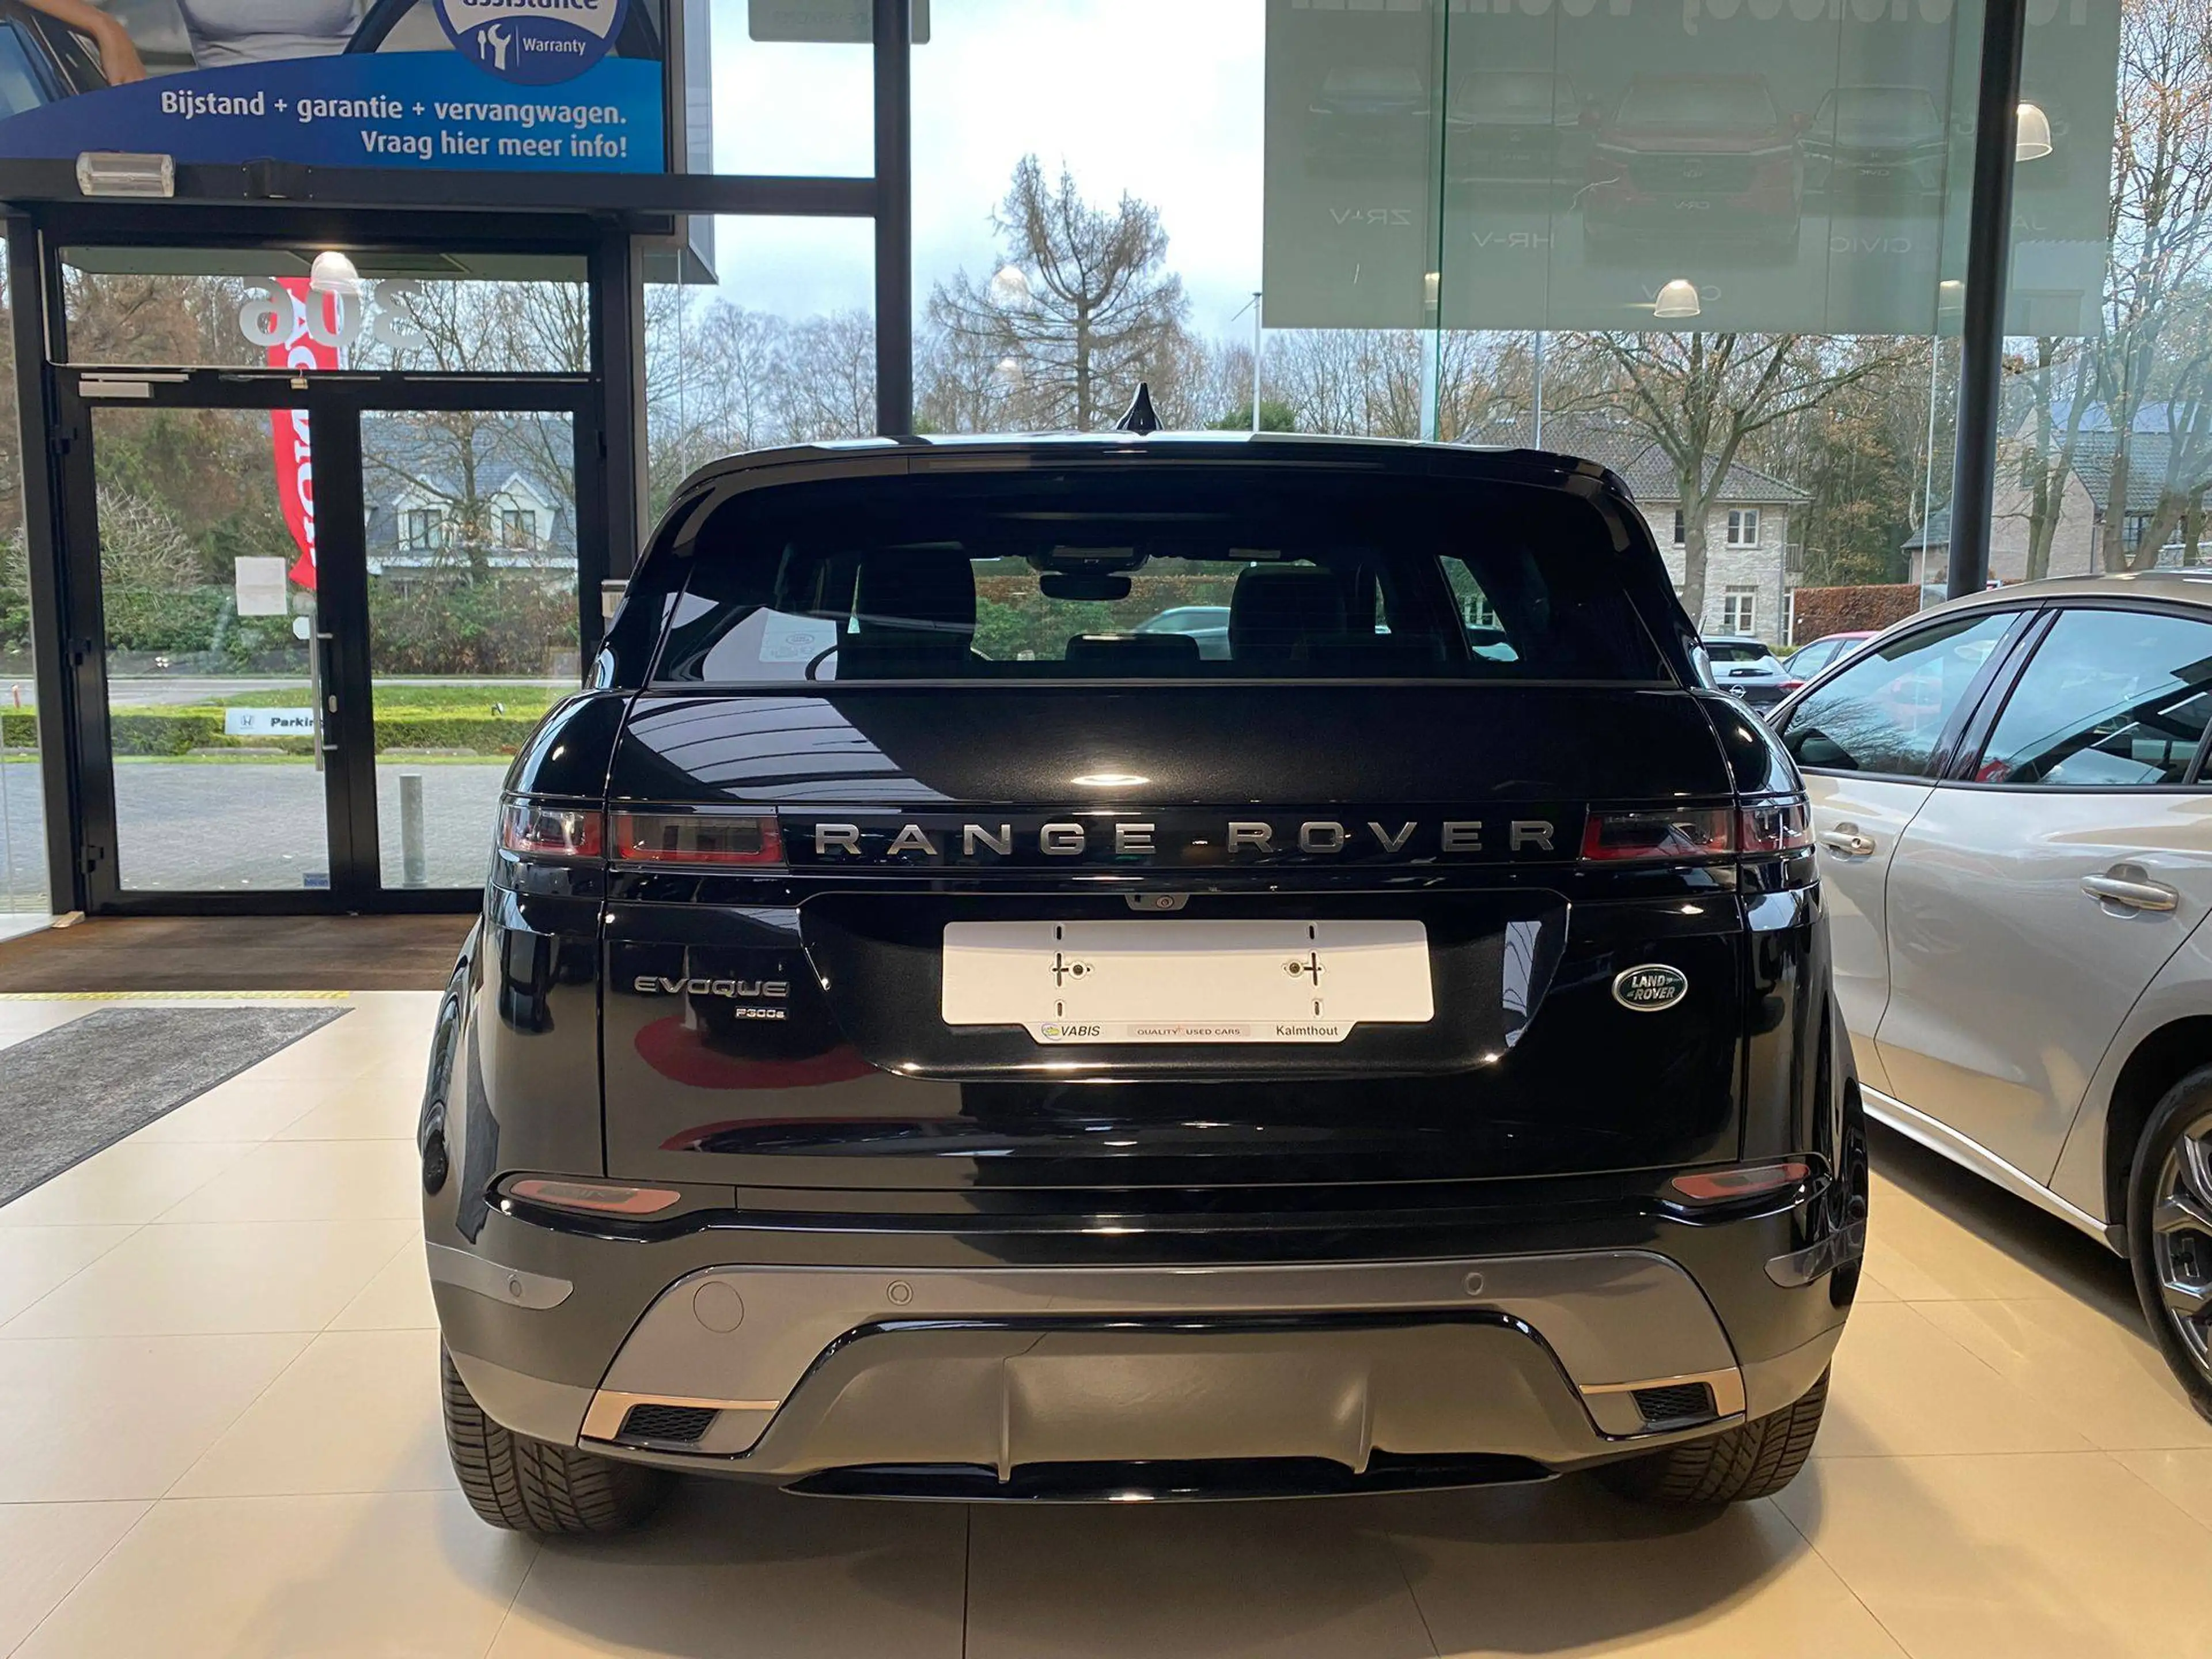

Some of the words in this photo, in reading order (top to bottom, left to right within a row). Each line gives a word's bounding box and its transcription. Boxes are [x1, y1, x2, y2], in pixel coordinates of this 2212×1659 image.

[522, 37, 586, 56] Warranty
[161, 89, 265, 119] Bijstand
[274, 99, 287, 113] +
[297, 94, 403, 123] garantie
[412, 102, 425, 116] +
[434, 102, 627, 130] vervangwagen.
[361, 131, 433, 160] Vraag
[441, 130, 490, 155] hier
[498, 137, 563, 157] meer
[570, 134, 627, 158] info!
[815, 822, 1157, 855] RANGE
[1228, 820, 1555, 853] ROVER
[634, 976, 789, 998] EVOQUE
[1631, 975, 1665, 988] LAND
[1633, 986, 1676, 1001] ROVER
[736, 1008, 785, 1019] P300e
[1061, 1025, 1101, 1037] VABIS
[1276, 1025, 1339, 1036] Kalmthout
